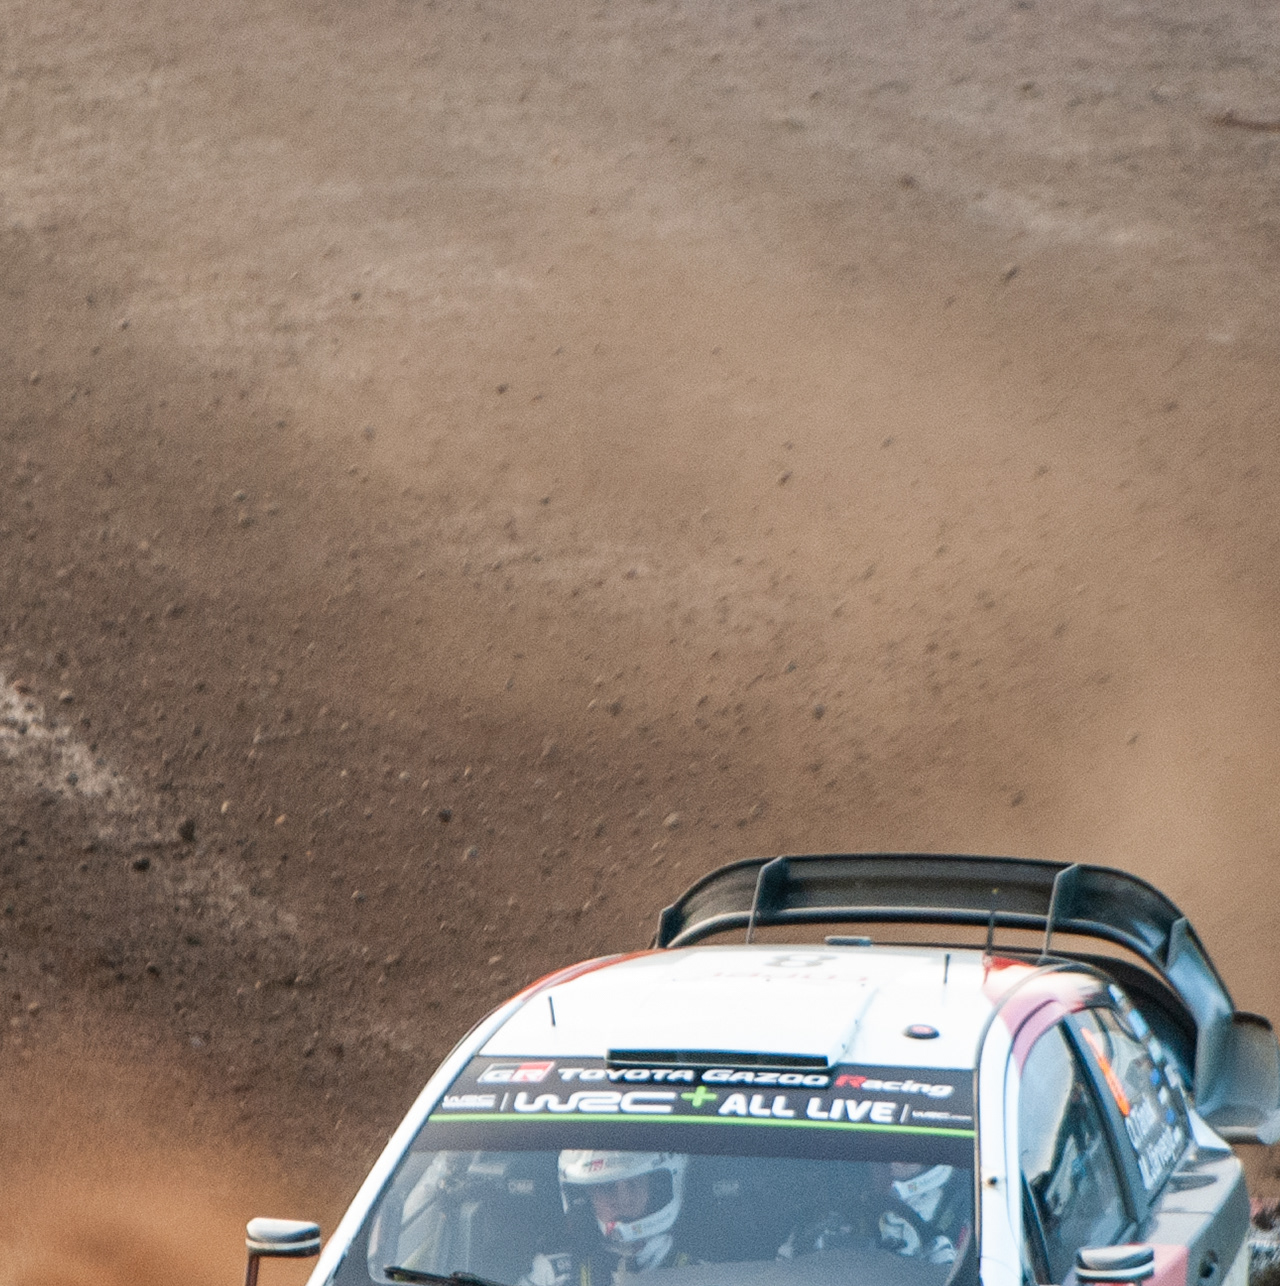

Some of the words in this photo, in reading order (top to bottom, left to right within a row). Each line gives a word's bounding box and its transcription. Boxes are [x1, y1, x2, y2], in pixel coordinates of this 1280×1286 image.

[558, 1067, 695, 1083] TOYOTA
[701, 1069, 830, 1086] GAZOO
[833, 1074, 955, 1098] Racing
[718, 1093, 795, 1118] ALL
[806, 1096, 898, 1123] LIVE
